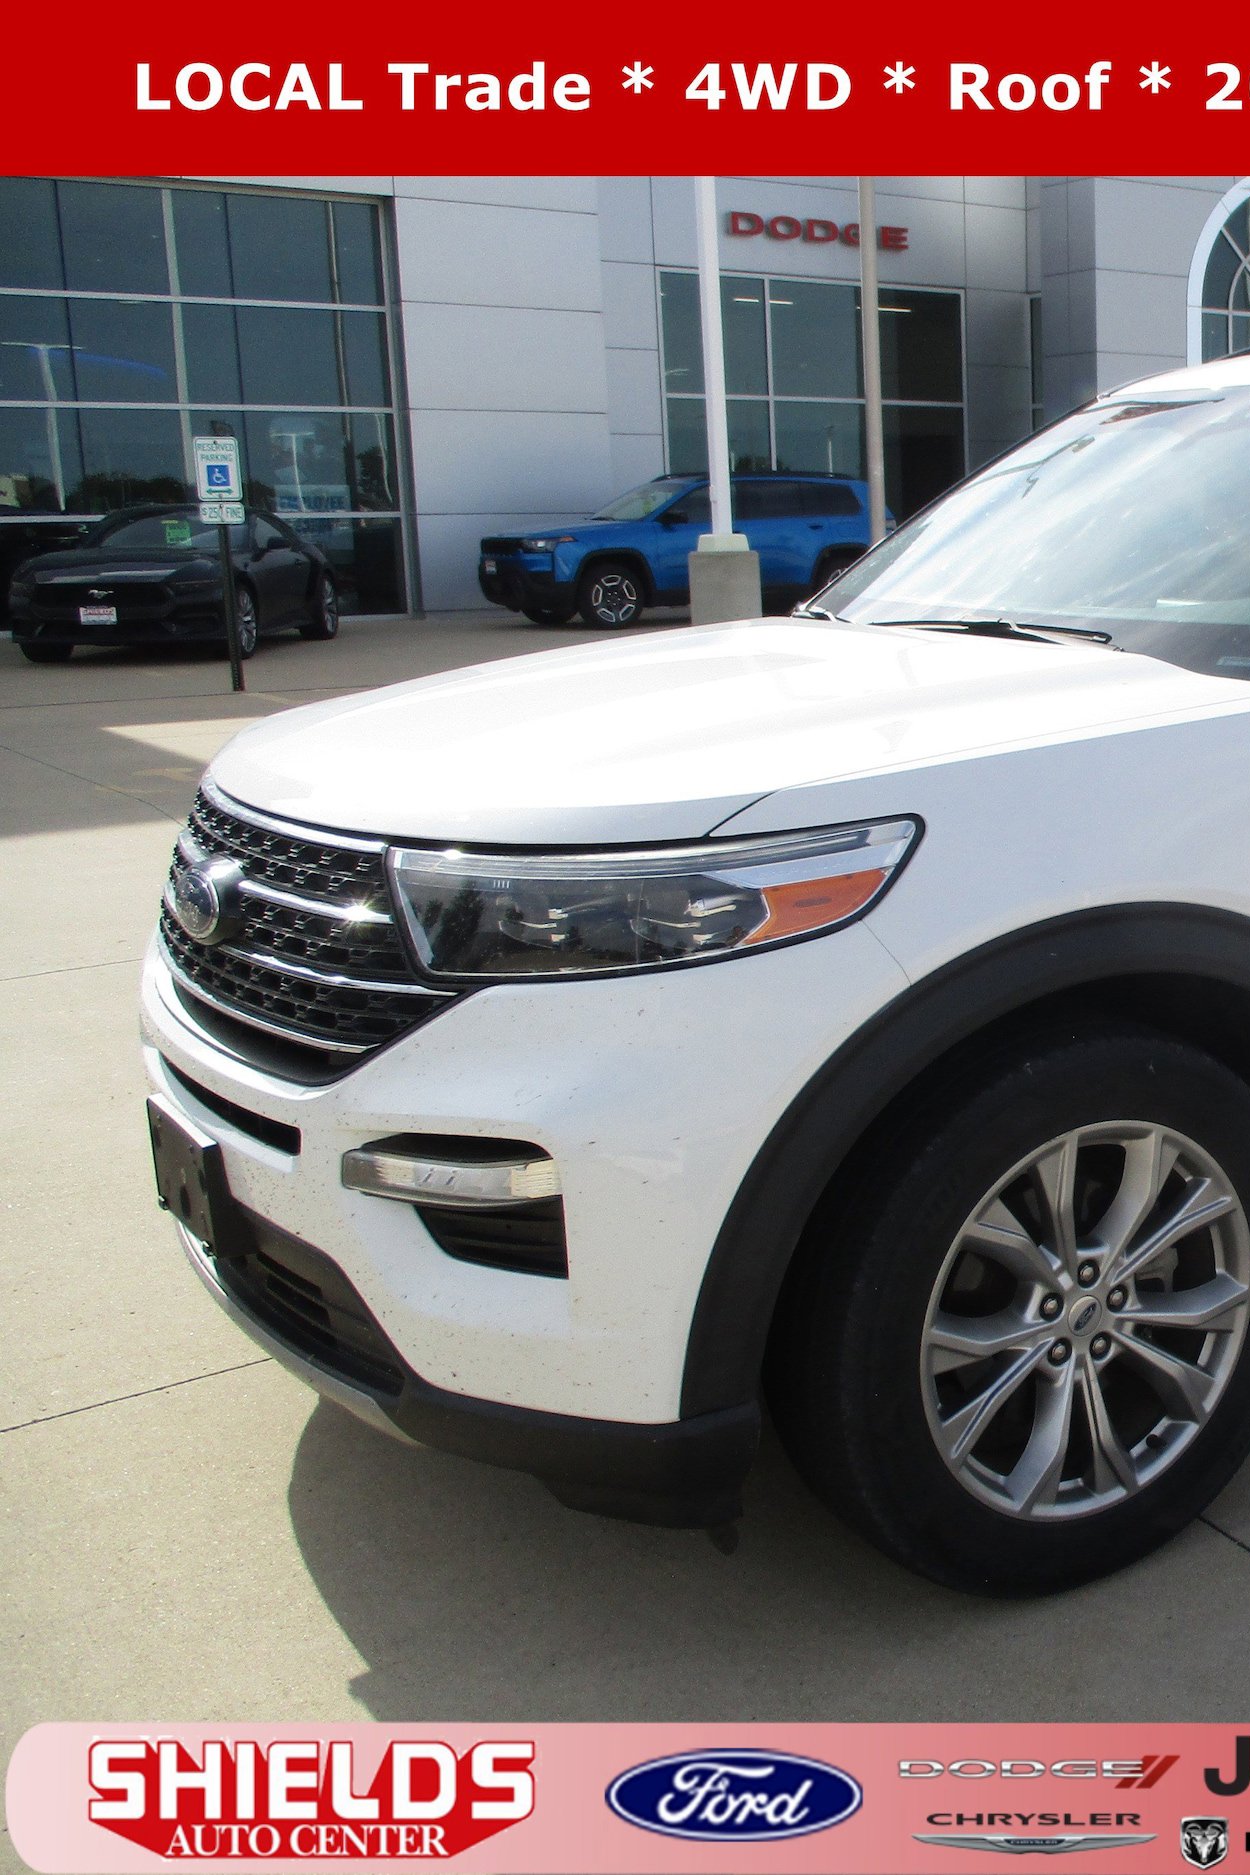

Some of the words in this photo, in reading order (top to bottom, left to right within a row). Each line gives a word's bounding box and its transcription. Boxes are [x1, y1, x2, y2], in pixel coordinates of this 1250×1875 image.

[196, 443, 234, 452] RESERVED
[201, 453, 233, 462] PARKING
[225, 506, 242, 519] FINE
